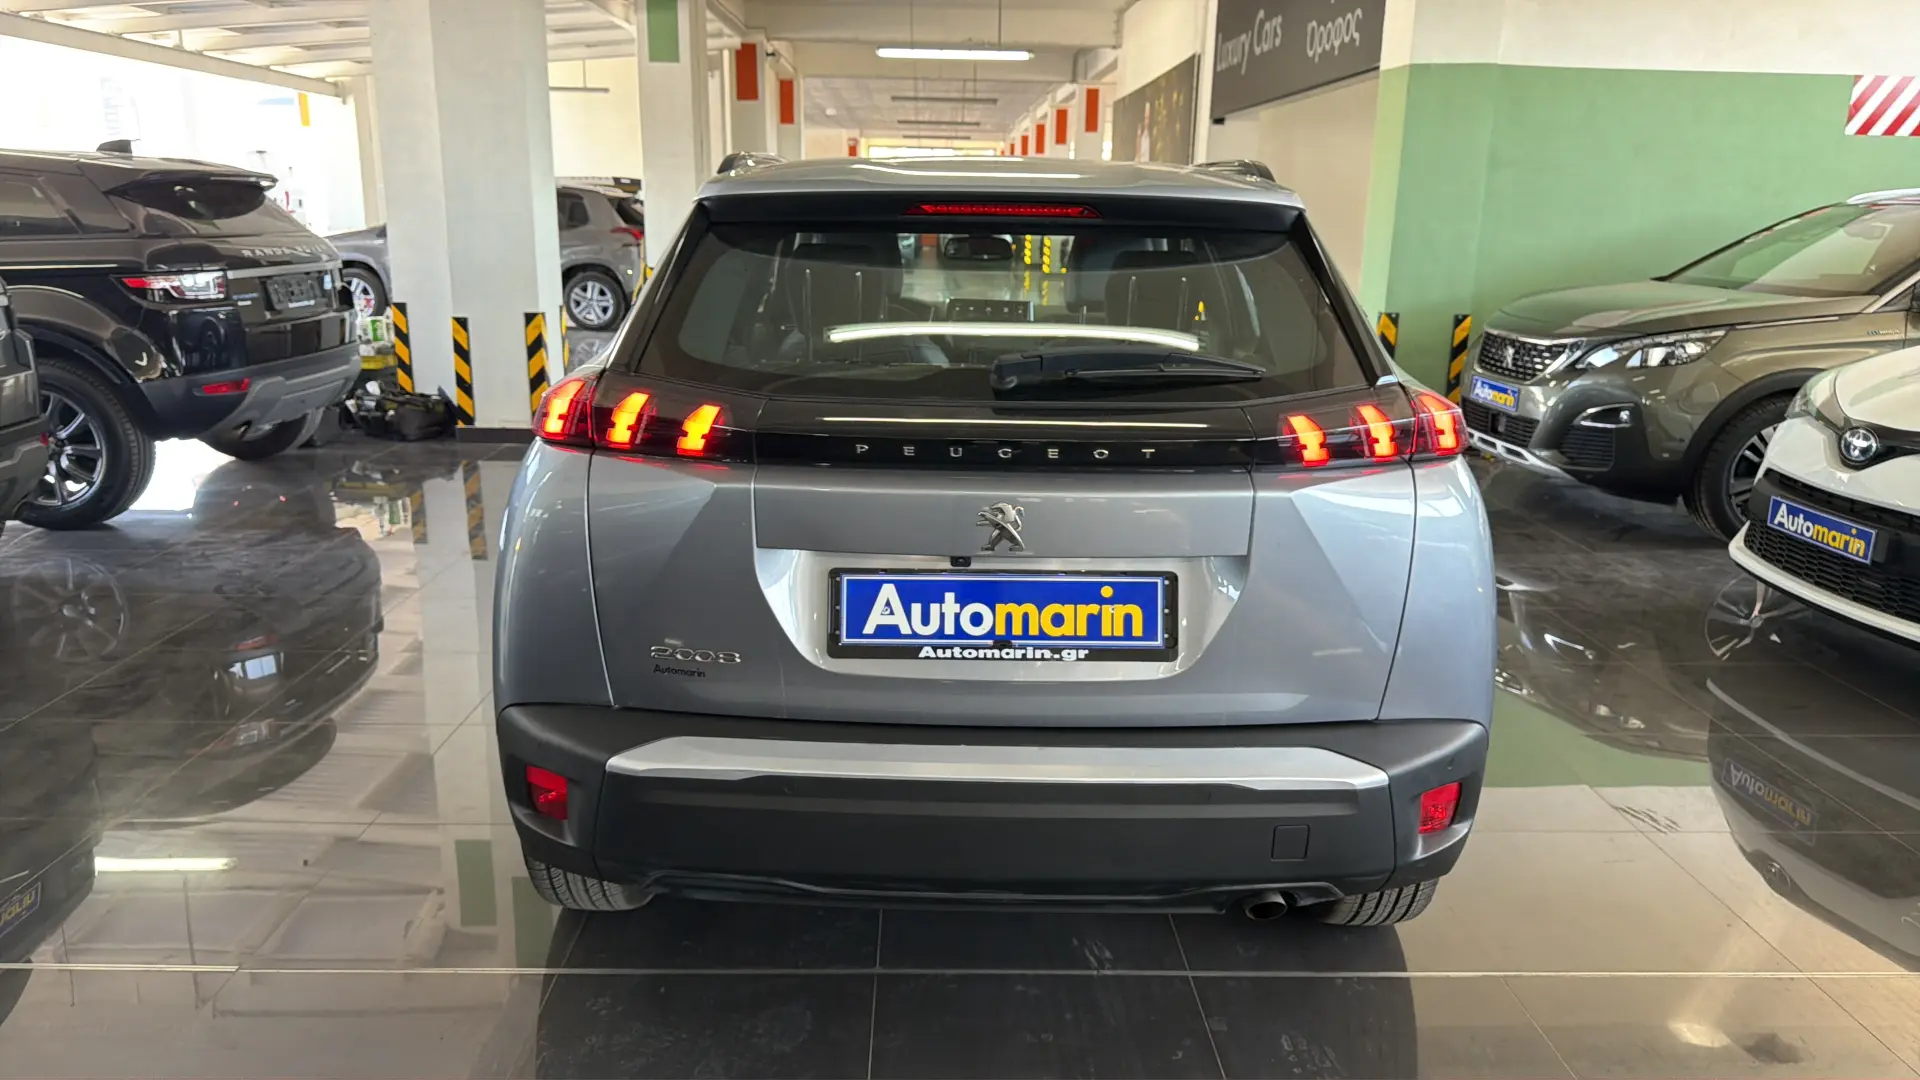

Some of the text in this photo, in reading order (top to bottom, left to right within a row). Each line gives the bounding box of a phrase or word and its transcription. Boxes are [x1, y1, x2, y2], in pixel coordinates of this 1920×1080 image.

[1216, 9, 1283, 76] Luxury Cars
[855, 444, 1155, 459] PEUGEOT
[1773, 502, 1866, 557] Automarin
[862, 583, 1143, 637] Automarin
[650, 645, 741, 664] 2008
[918, 645, 1089, 661] Automarin.gr
[653, 663, 706, 678] Automarin
